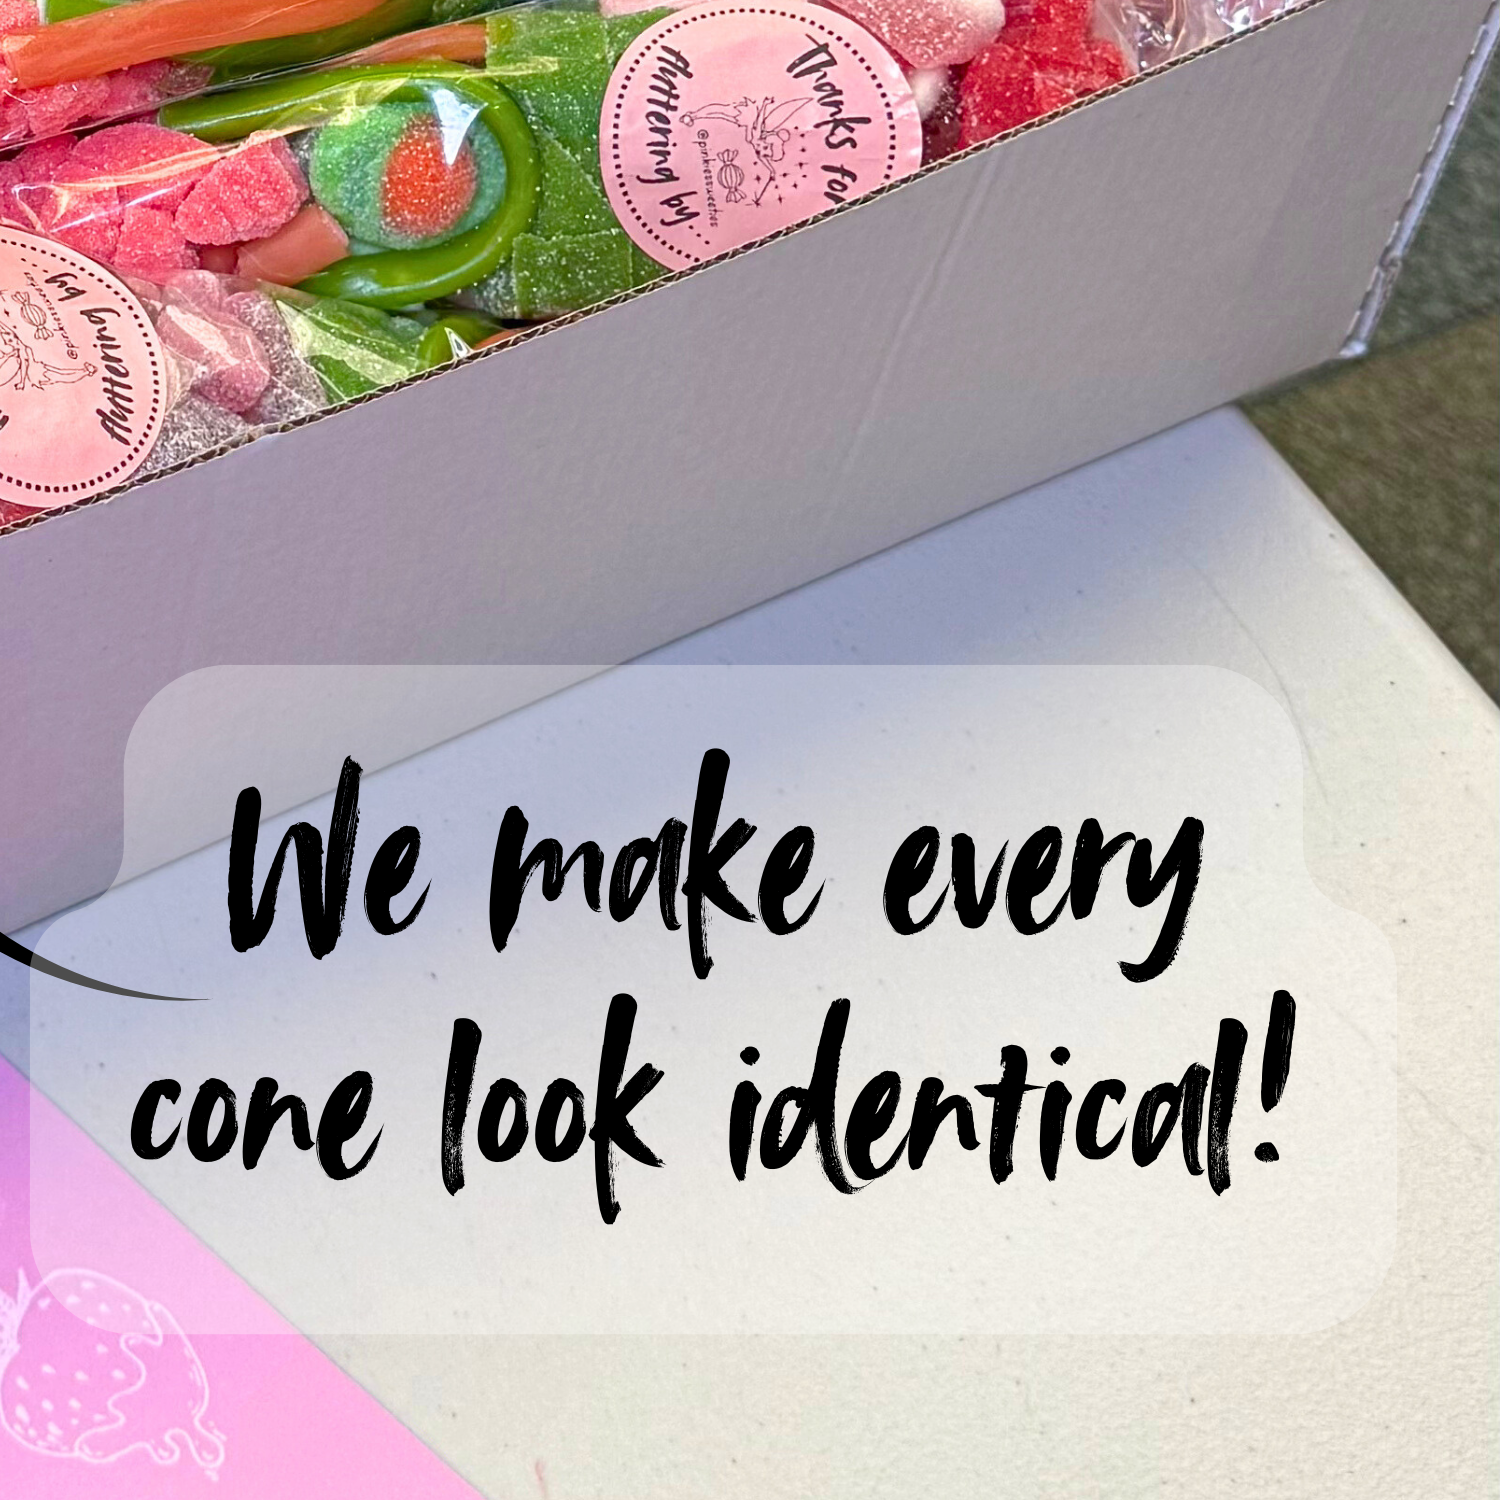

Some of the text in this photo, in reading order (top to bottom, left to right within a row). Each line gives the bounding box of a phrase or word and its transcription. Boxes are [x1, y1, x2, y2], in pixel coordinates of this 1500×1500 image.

[636, 45, 693, 184] fluttering
[787, 33, 871, 151] Thanks
[80, 307, 134, 446] fluttering
